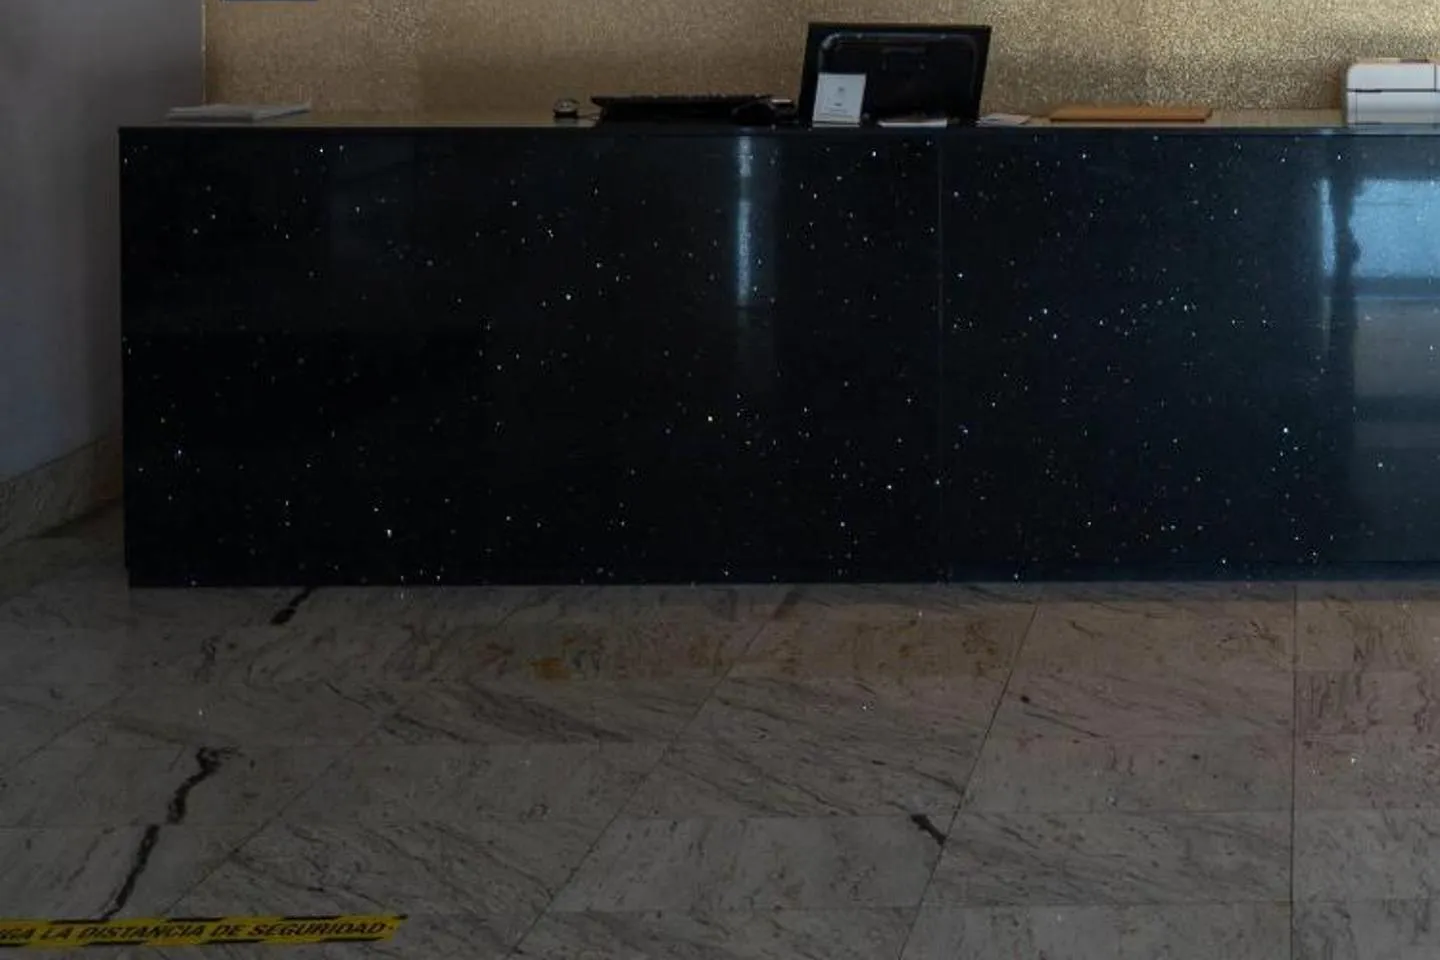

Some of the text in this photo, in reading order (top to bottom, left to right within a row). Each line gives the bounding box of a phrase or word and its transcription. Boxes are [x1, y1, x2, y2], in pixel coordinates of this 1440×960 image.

[41, 927, 73, 940] LA
[77, 925, 206, 939] DISTANCIA
[209, 924, 245, 937] DE
[248, 921, 386, 936] SEGURIDAD
